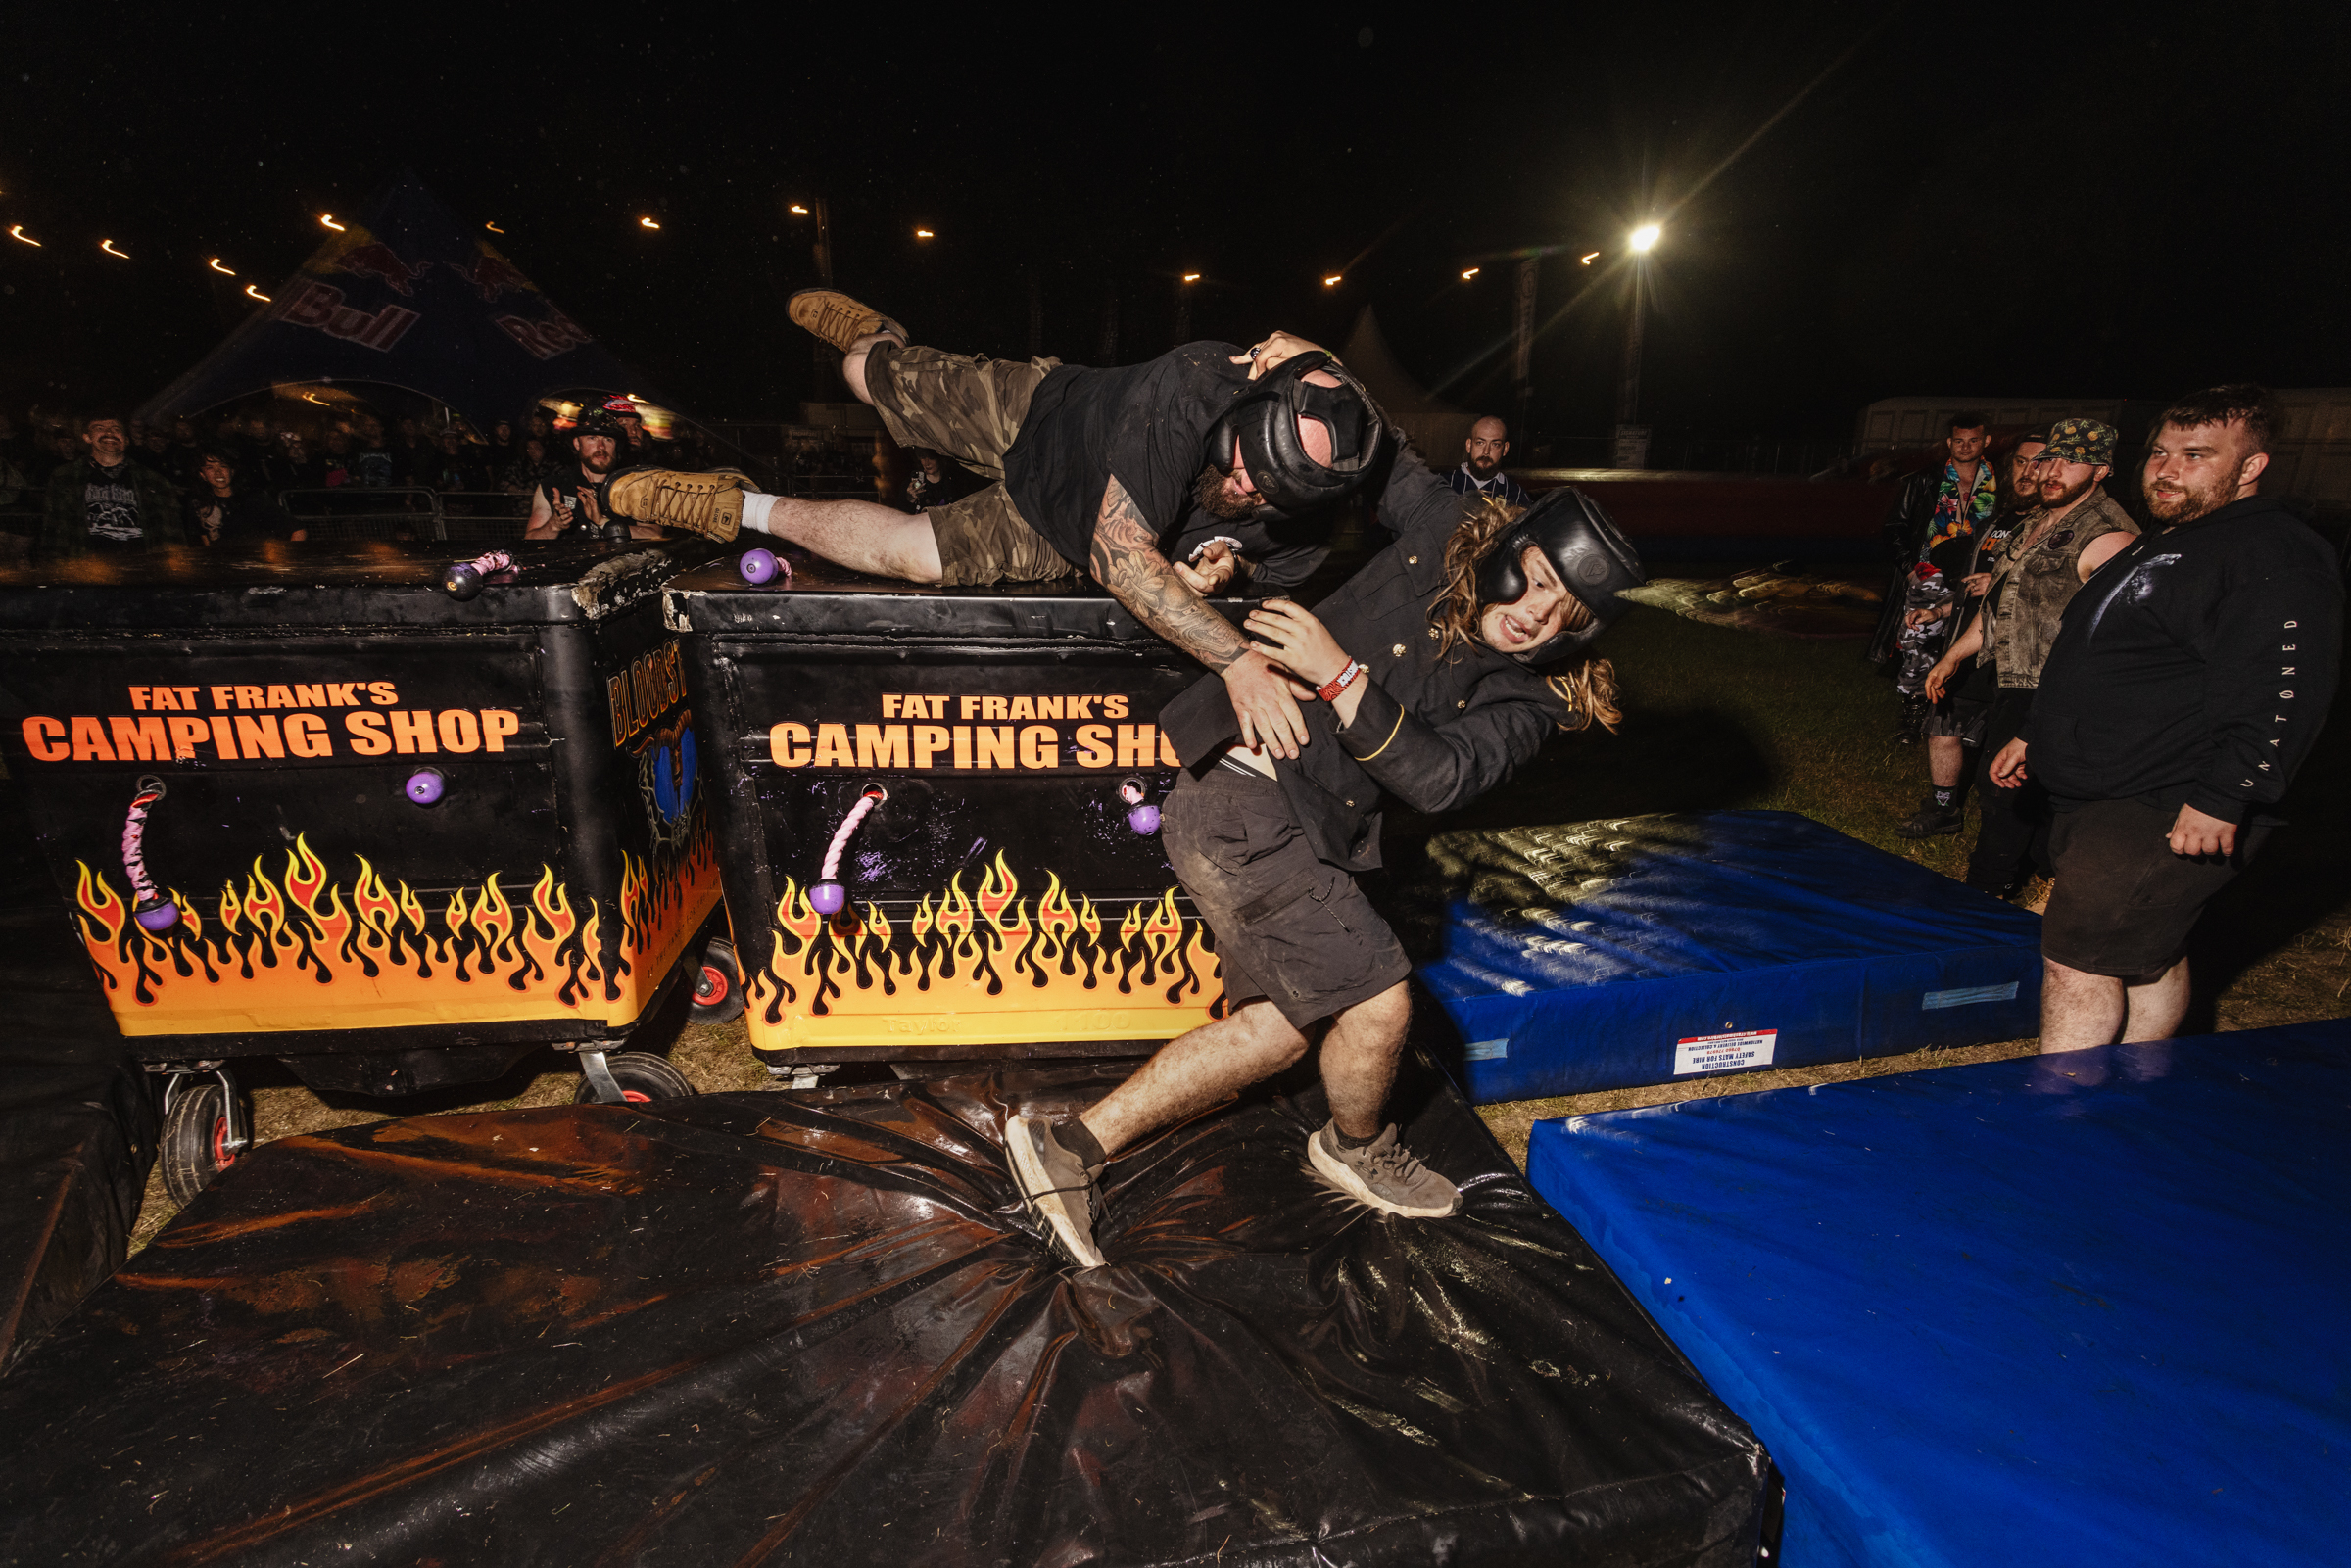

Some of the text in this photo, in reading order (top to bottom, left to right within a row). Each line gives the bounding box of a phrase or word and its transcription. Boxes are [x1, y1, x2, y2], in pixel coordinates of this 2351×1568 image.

[281, 282, 421, 353] Bull
[495, 298, 593, 359] Red
[128, 681, 400, 710] FAT FRANK'S
[882, 694, 1129, 720] FAT FRANK'S
[22, 709, 518, 762] CAMPING SHOP
[769, 722, 1059, 769] CAMPING
[882, 1017, 963, 1035] Taylor
[1702, 1059, 1745, 1070] CONSTRUCTION
